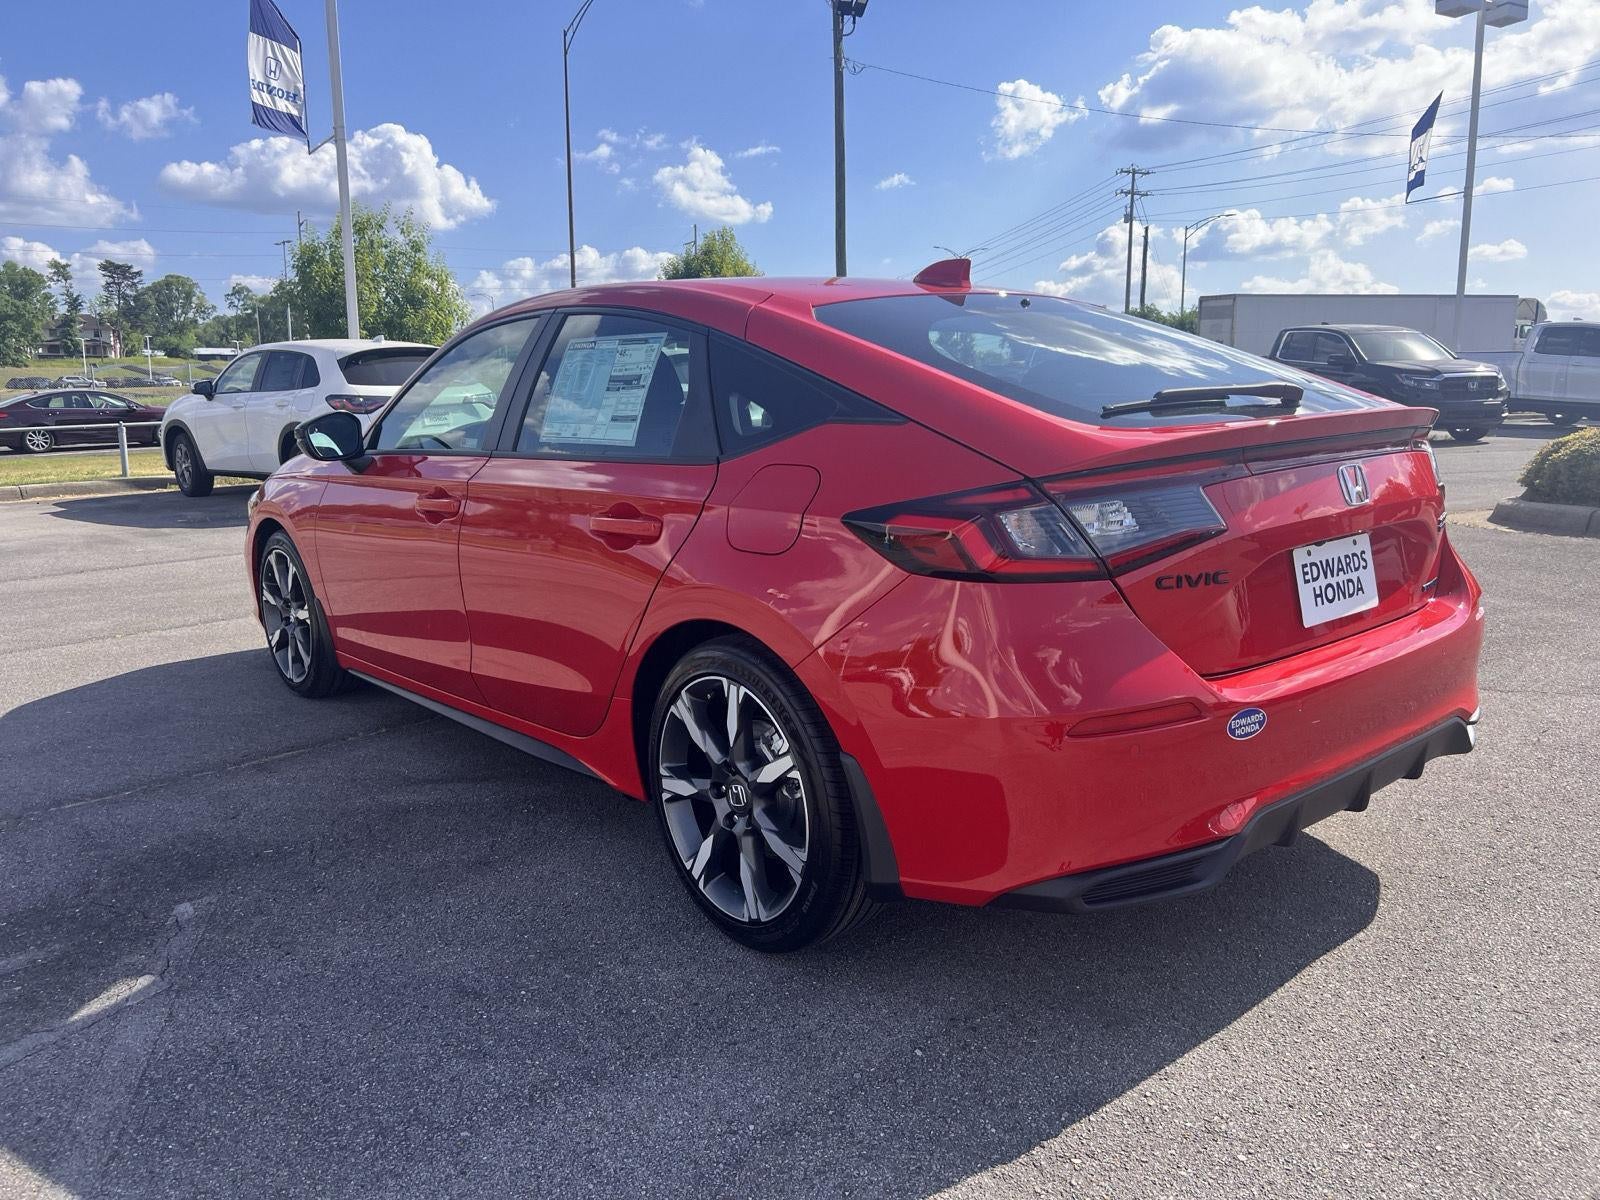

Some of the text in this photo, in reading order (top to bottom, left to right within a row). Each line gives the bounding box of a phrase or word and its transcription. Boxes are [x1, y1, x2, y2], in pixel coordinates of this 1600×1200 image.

[1301, 550, 1368, 585] EDWARDS
[1155, 570, 1231, 590] CIVIC
[1313, 576, 1365, 607] HONDA
[1231, 712, 1264, 729] EDWARDS
[1235, 723, 1260, 736] HONDA
